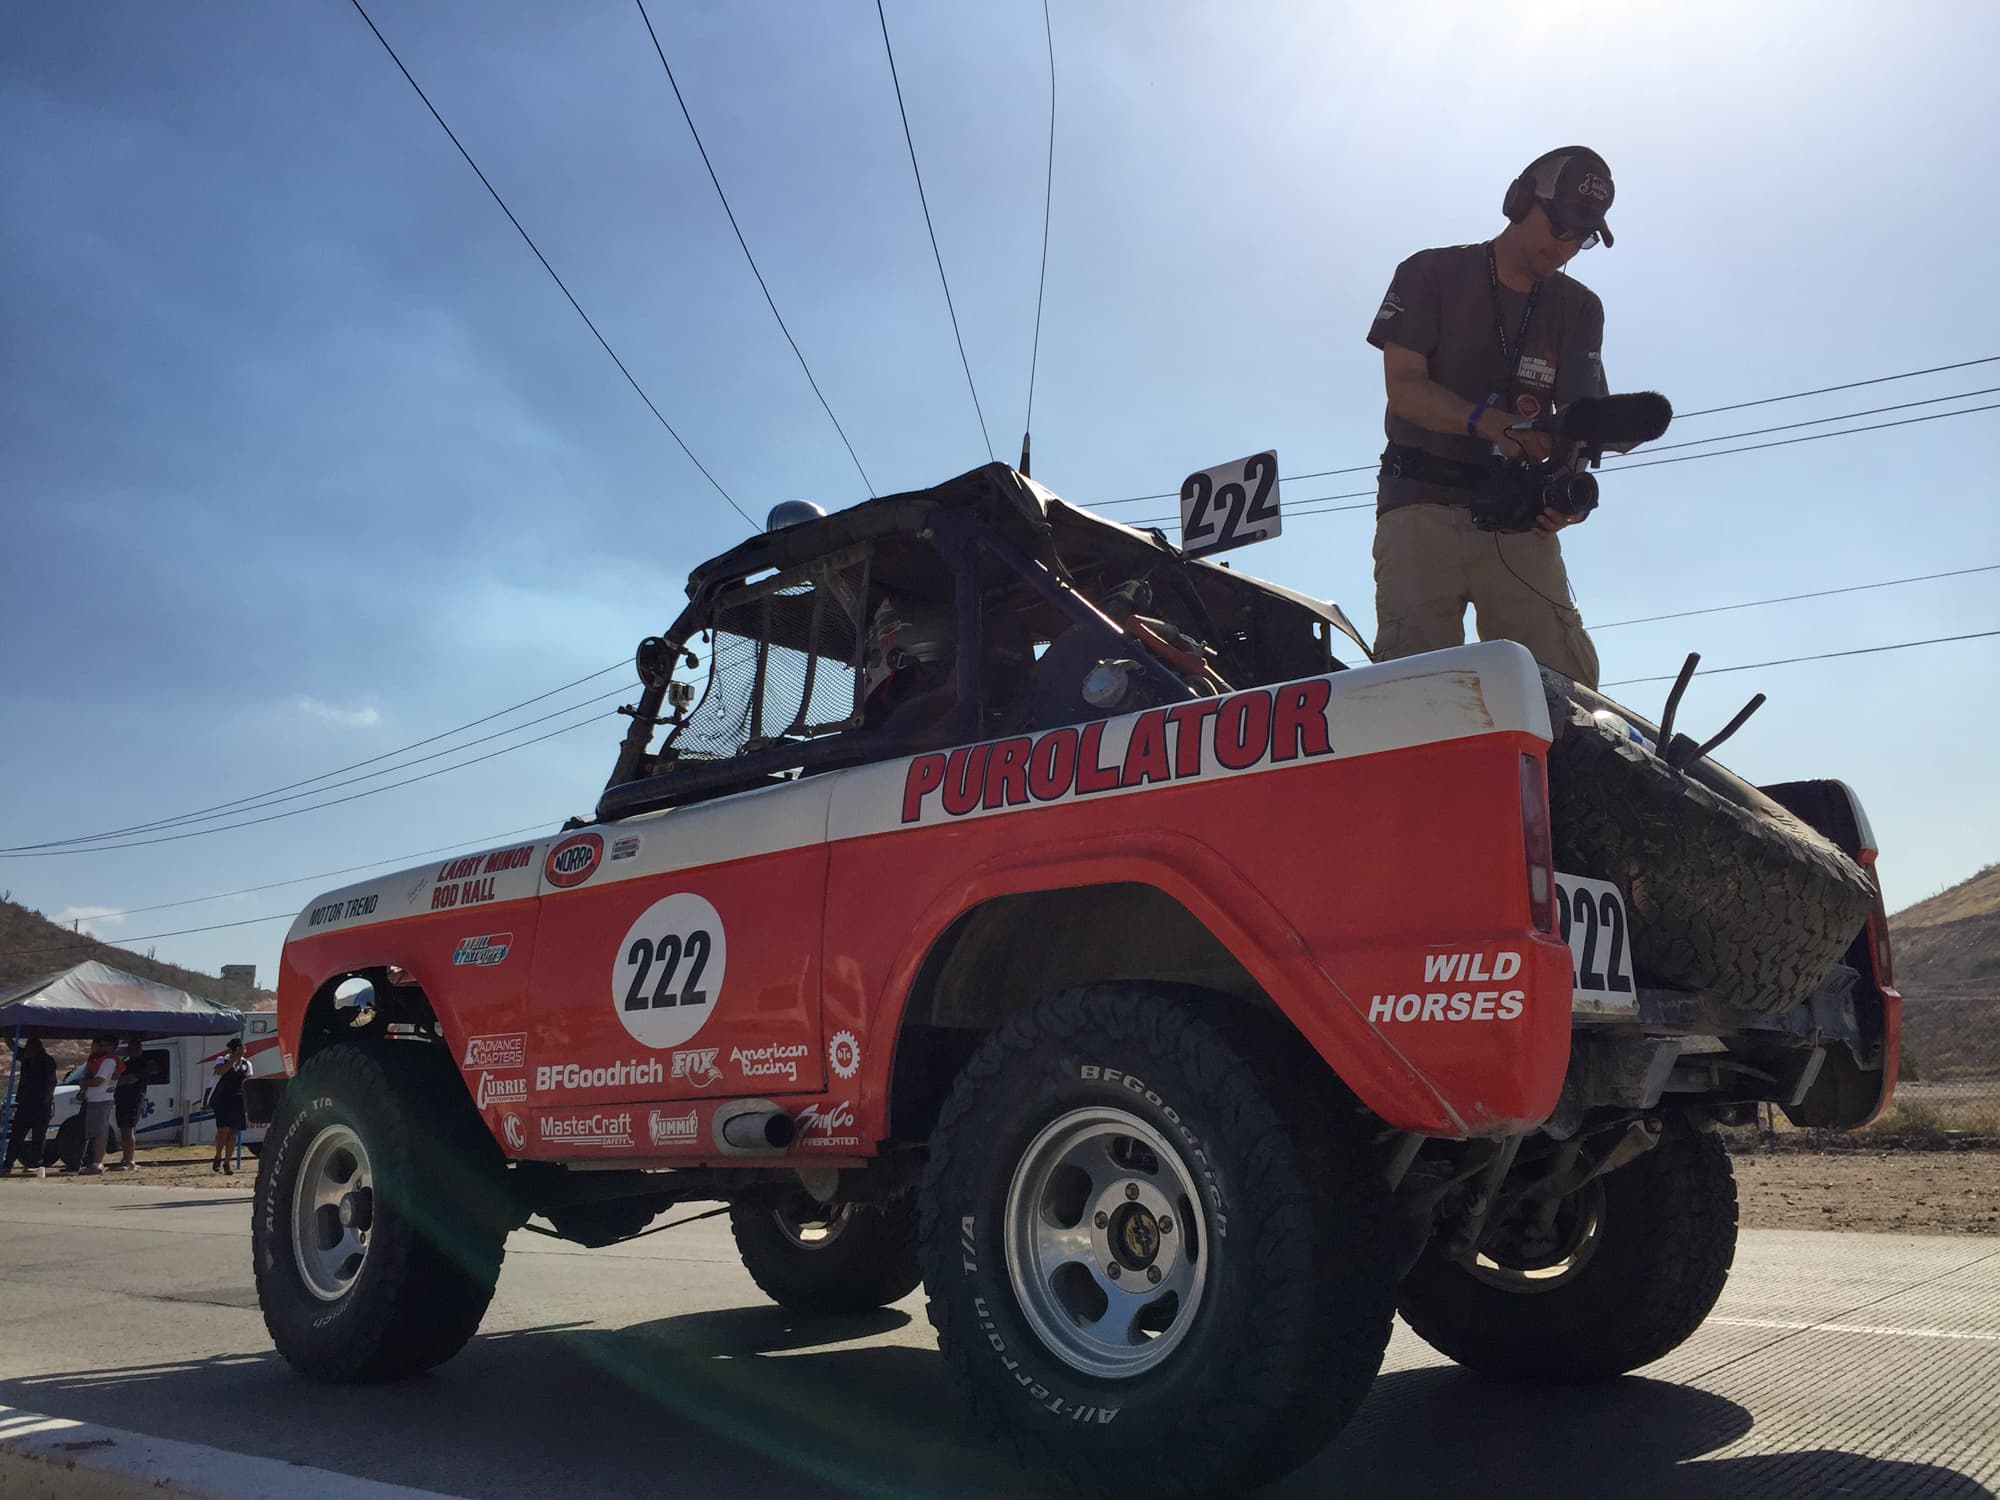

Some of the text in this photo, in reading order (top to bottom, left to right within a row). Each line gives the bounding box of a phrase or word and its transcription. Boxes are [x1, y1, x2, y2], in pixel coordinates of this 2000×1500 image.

[1181, 453, 1278, 553] 222
[902, 678, 1335, 824] PUROLATOR
[436, 845, 535, 882] LARRY MINOR
[431, 884, 458, 910] ROD
[460, 877, 495, 905] HALL
[307, 894, 379, 928] MOTOR TREND
[625, 930, 711, 1012] 222
[1424, 952, 1521, 983] WILD
[1368, 990, 1525, 1023] HORSES
[474, 1051, 522, 1064] ADAPTERS
[480, 1038, 522, 1052] ADVANCE
[729, 1042, 808, 1062] American
[536, 1057, 663, 1091] BFGoodrich
[673, 1049, 717, 1077] FOX
[742, 1059, 797, 1081] Racing
[311, 1097, 333, 1111] T/A
[477, 1070, 528, 1110] CURRIE
[503, 1114, 525, 1148] KC
[540, 1113, 632, 1137] MasterCraft
[649, 1111, 697, 1146] SUMMIT
[961, 1216, 1120, 1424] All-Terrain T/A
